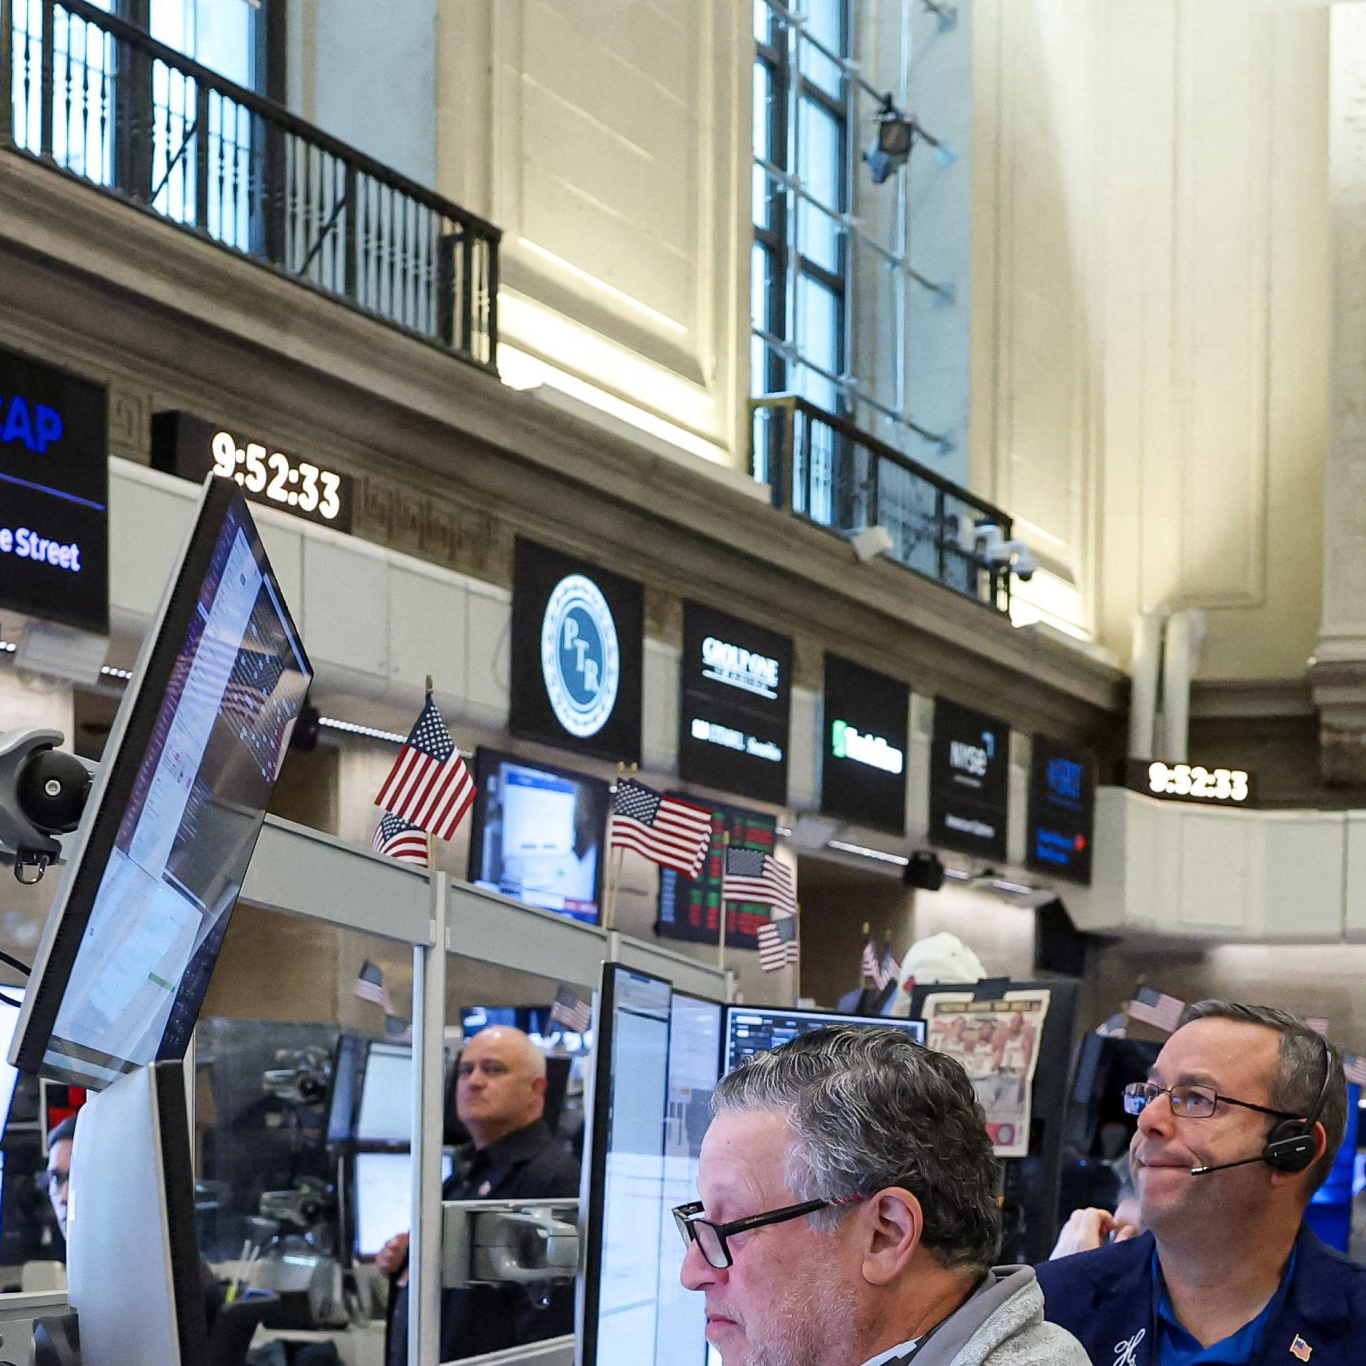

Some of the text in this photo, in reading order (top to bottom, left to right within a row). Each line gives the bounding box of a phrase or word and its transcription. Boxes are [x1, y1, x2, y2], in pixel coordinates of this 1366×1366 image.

[212, 432, 340, 520] 9:52:33
[15, 527, 81, 572] Street
[563, 616, 601, 694] PTR
[1149, 762, 1248, 801] 9:52:33
